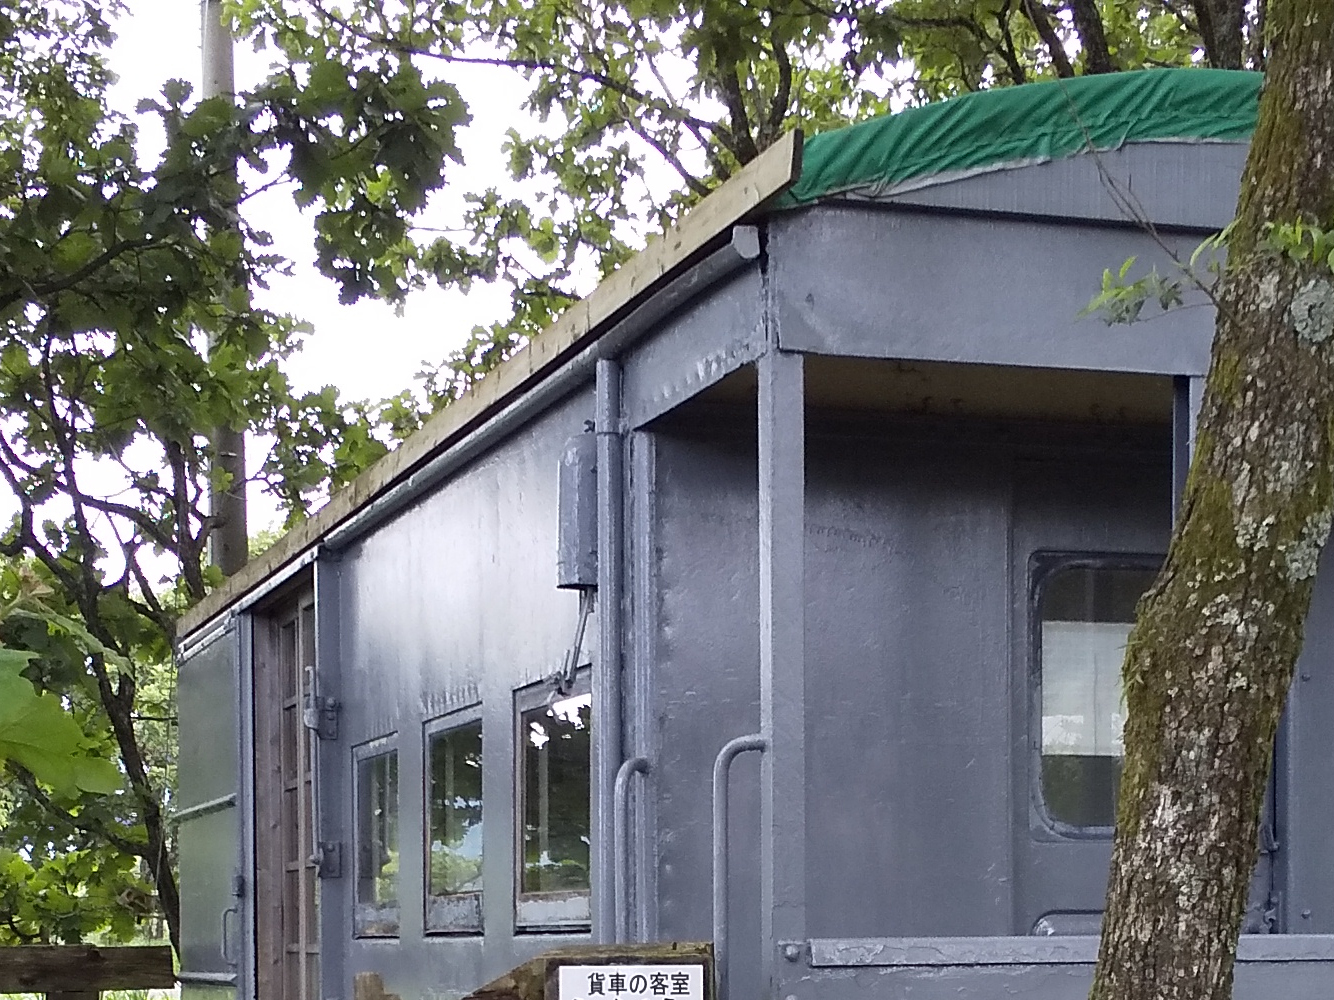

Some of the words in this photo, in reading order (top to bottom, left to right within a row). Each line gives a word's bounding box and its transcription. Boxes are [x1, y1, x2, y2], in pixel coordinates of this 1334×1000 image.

[587, 972, 690, 996] 貨車の客室
